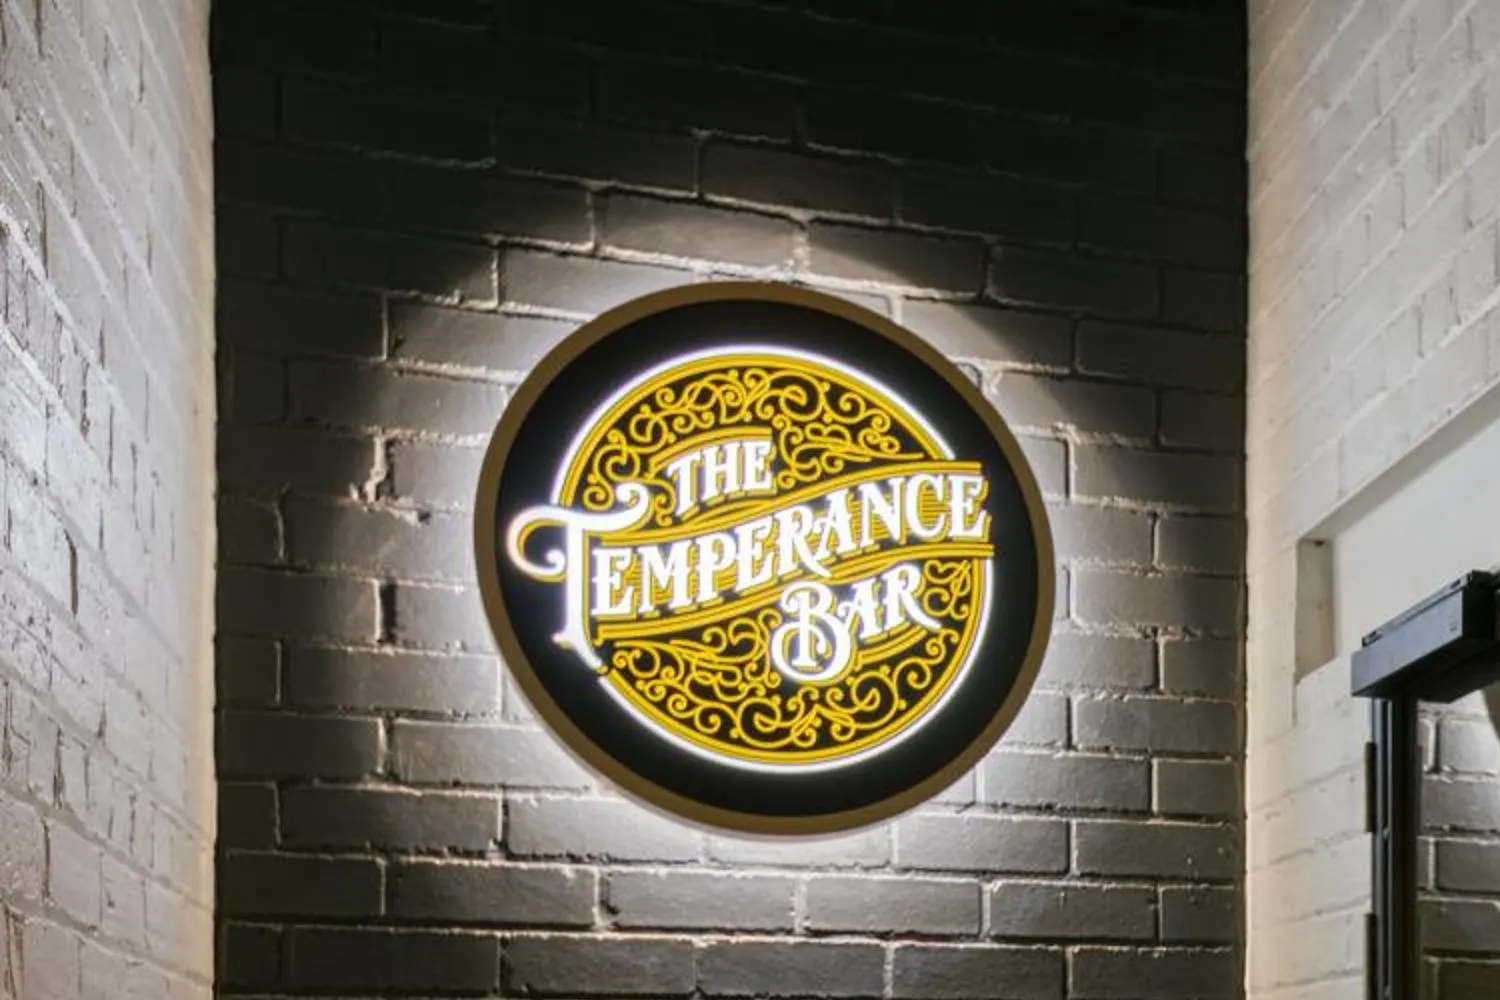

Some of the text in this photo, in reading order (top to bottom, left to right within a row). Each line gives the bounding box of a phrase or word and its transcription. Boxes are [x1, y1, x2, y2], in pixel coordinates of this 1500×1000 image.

[666, 440, 774, 517] THE
[507, 473, 990, 669] TEMPERANCE
[771, 563, 943, 682] BAR
